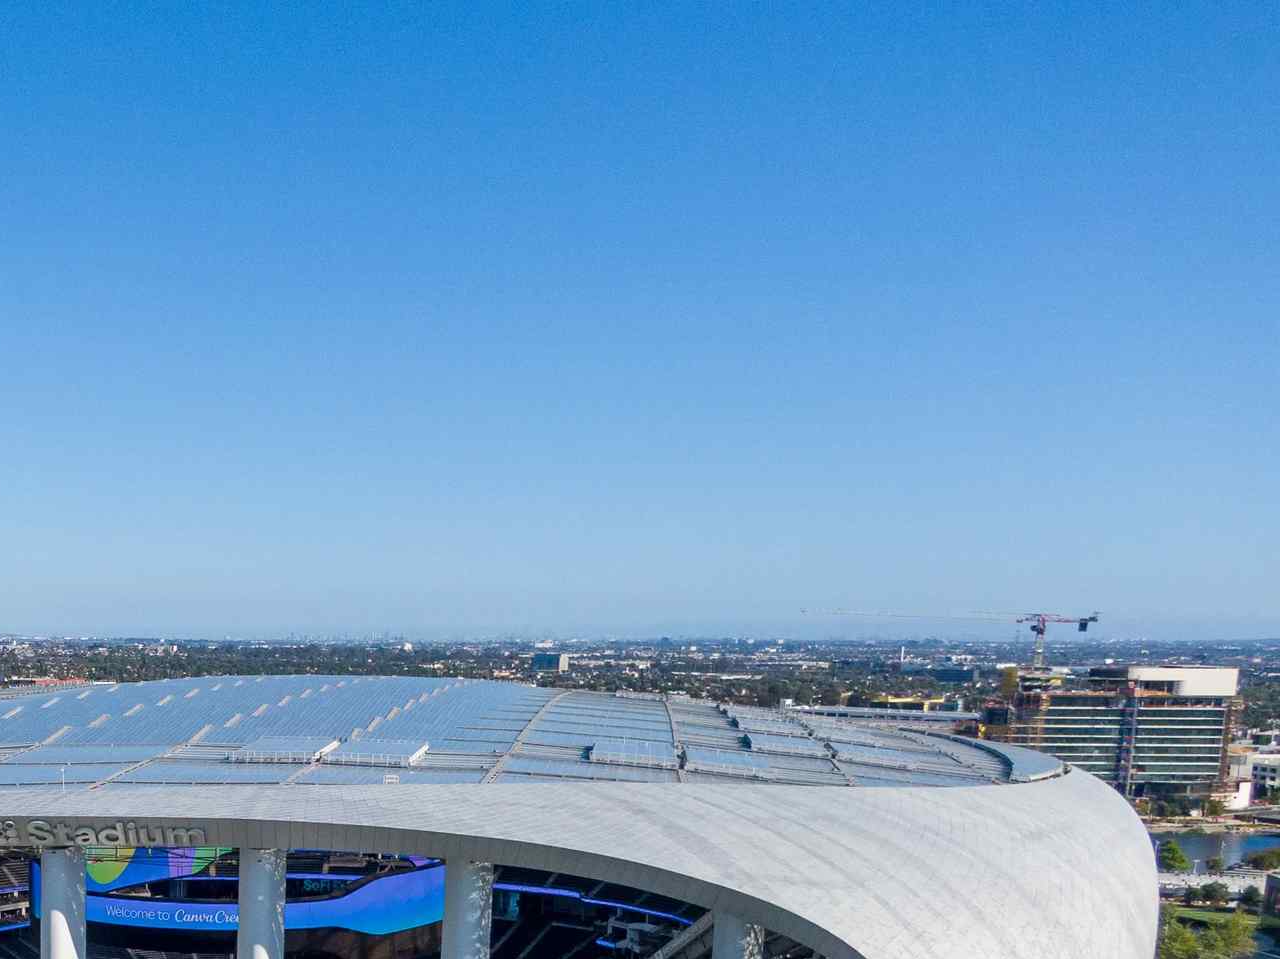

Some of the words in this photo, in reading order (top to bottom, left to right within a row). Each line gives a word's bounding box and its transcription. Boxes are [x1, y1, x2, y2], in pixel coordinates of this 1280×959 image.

[27, 820, 207, 847] Stadium
[105, 903, 156, 920] Welcome
[158, 909, 170, 921] to
